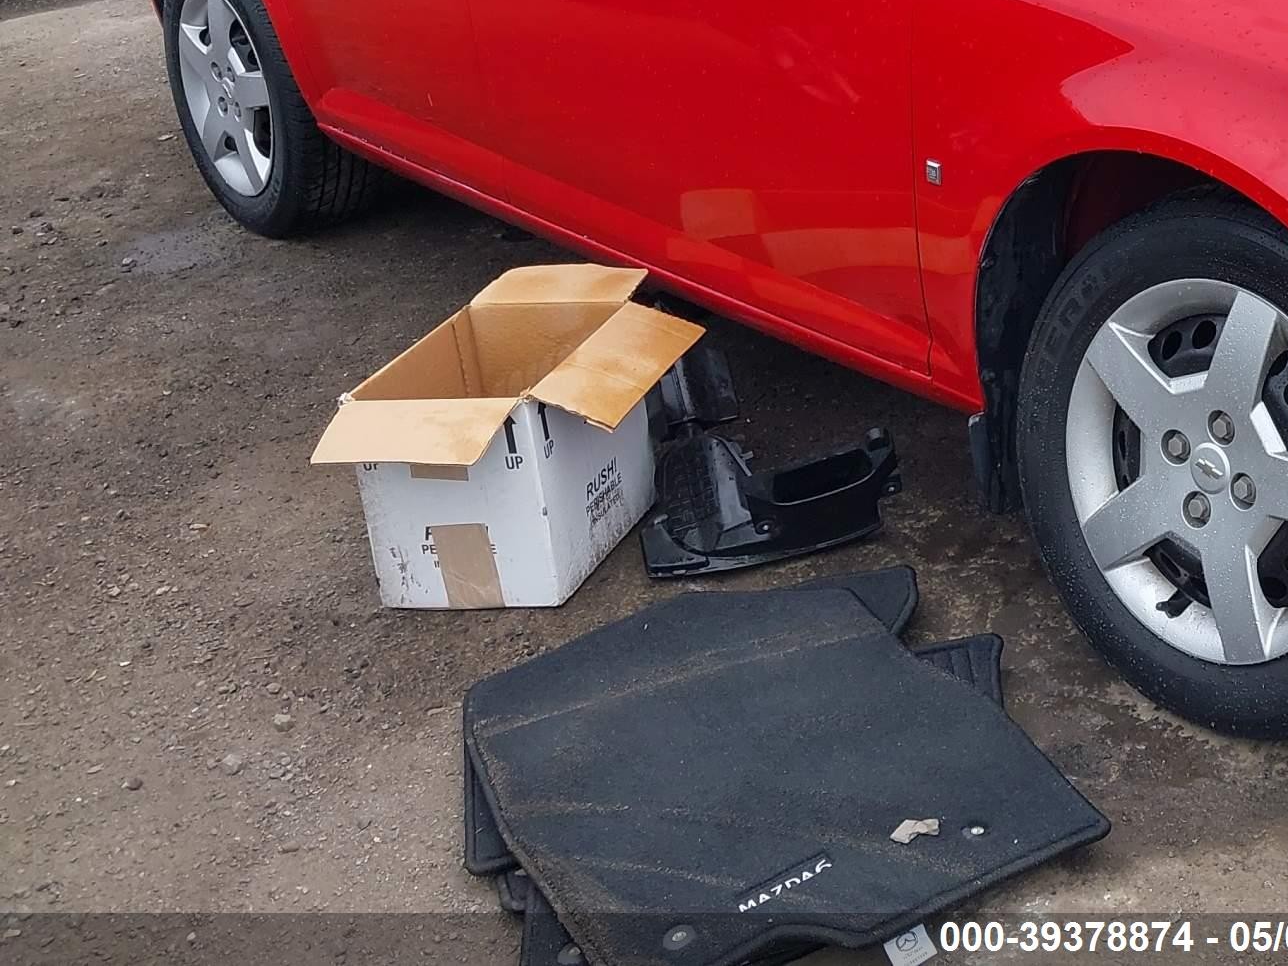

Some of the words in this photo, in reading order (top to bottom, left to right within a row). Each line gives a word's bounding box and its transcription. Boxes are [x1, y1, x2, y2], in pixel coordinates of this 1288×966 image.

[544, 439, 555, 459] UP
[505, 456, 524, 470] UP
[586, 456, 617, 501] RUSH!
